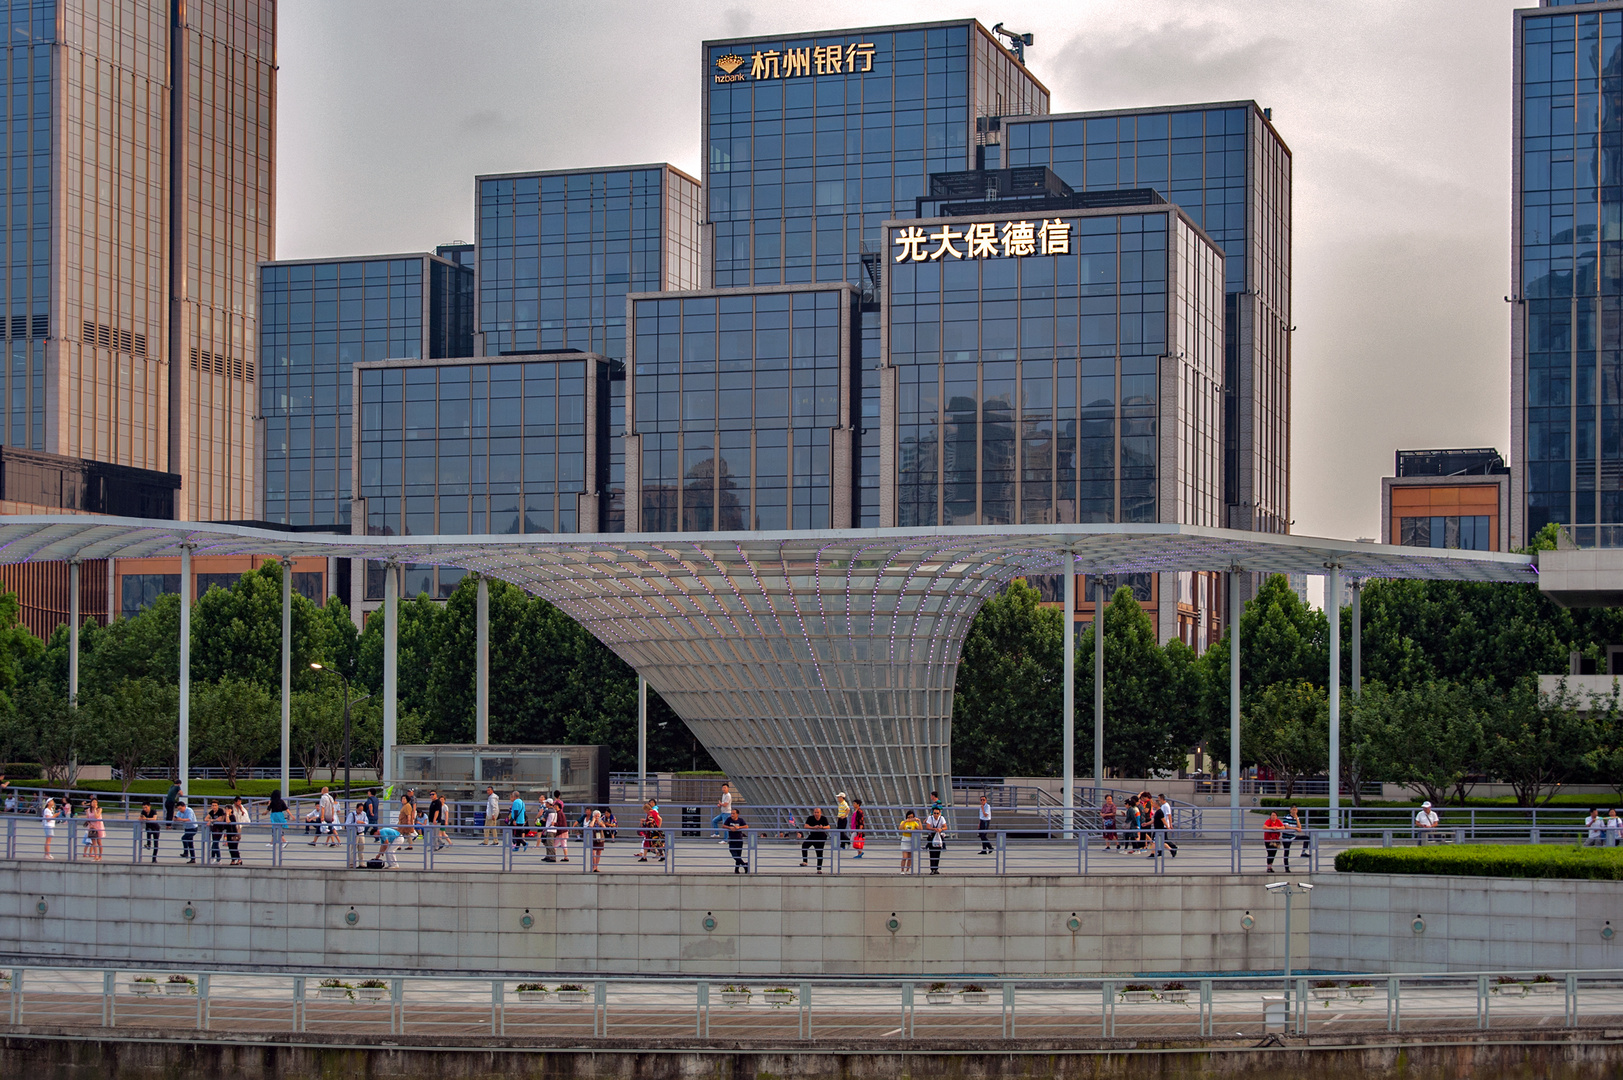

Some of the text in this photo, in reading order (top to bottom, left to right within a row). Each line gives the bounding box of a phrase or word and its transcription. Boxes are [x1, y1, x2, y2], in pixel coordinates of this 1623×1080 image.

[714, 72, 745, 83] hzbank
[750, 42, 876, 80] 杭州银行
[895, 217, 1071, 262] 光大保德信
